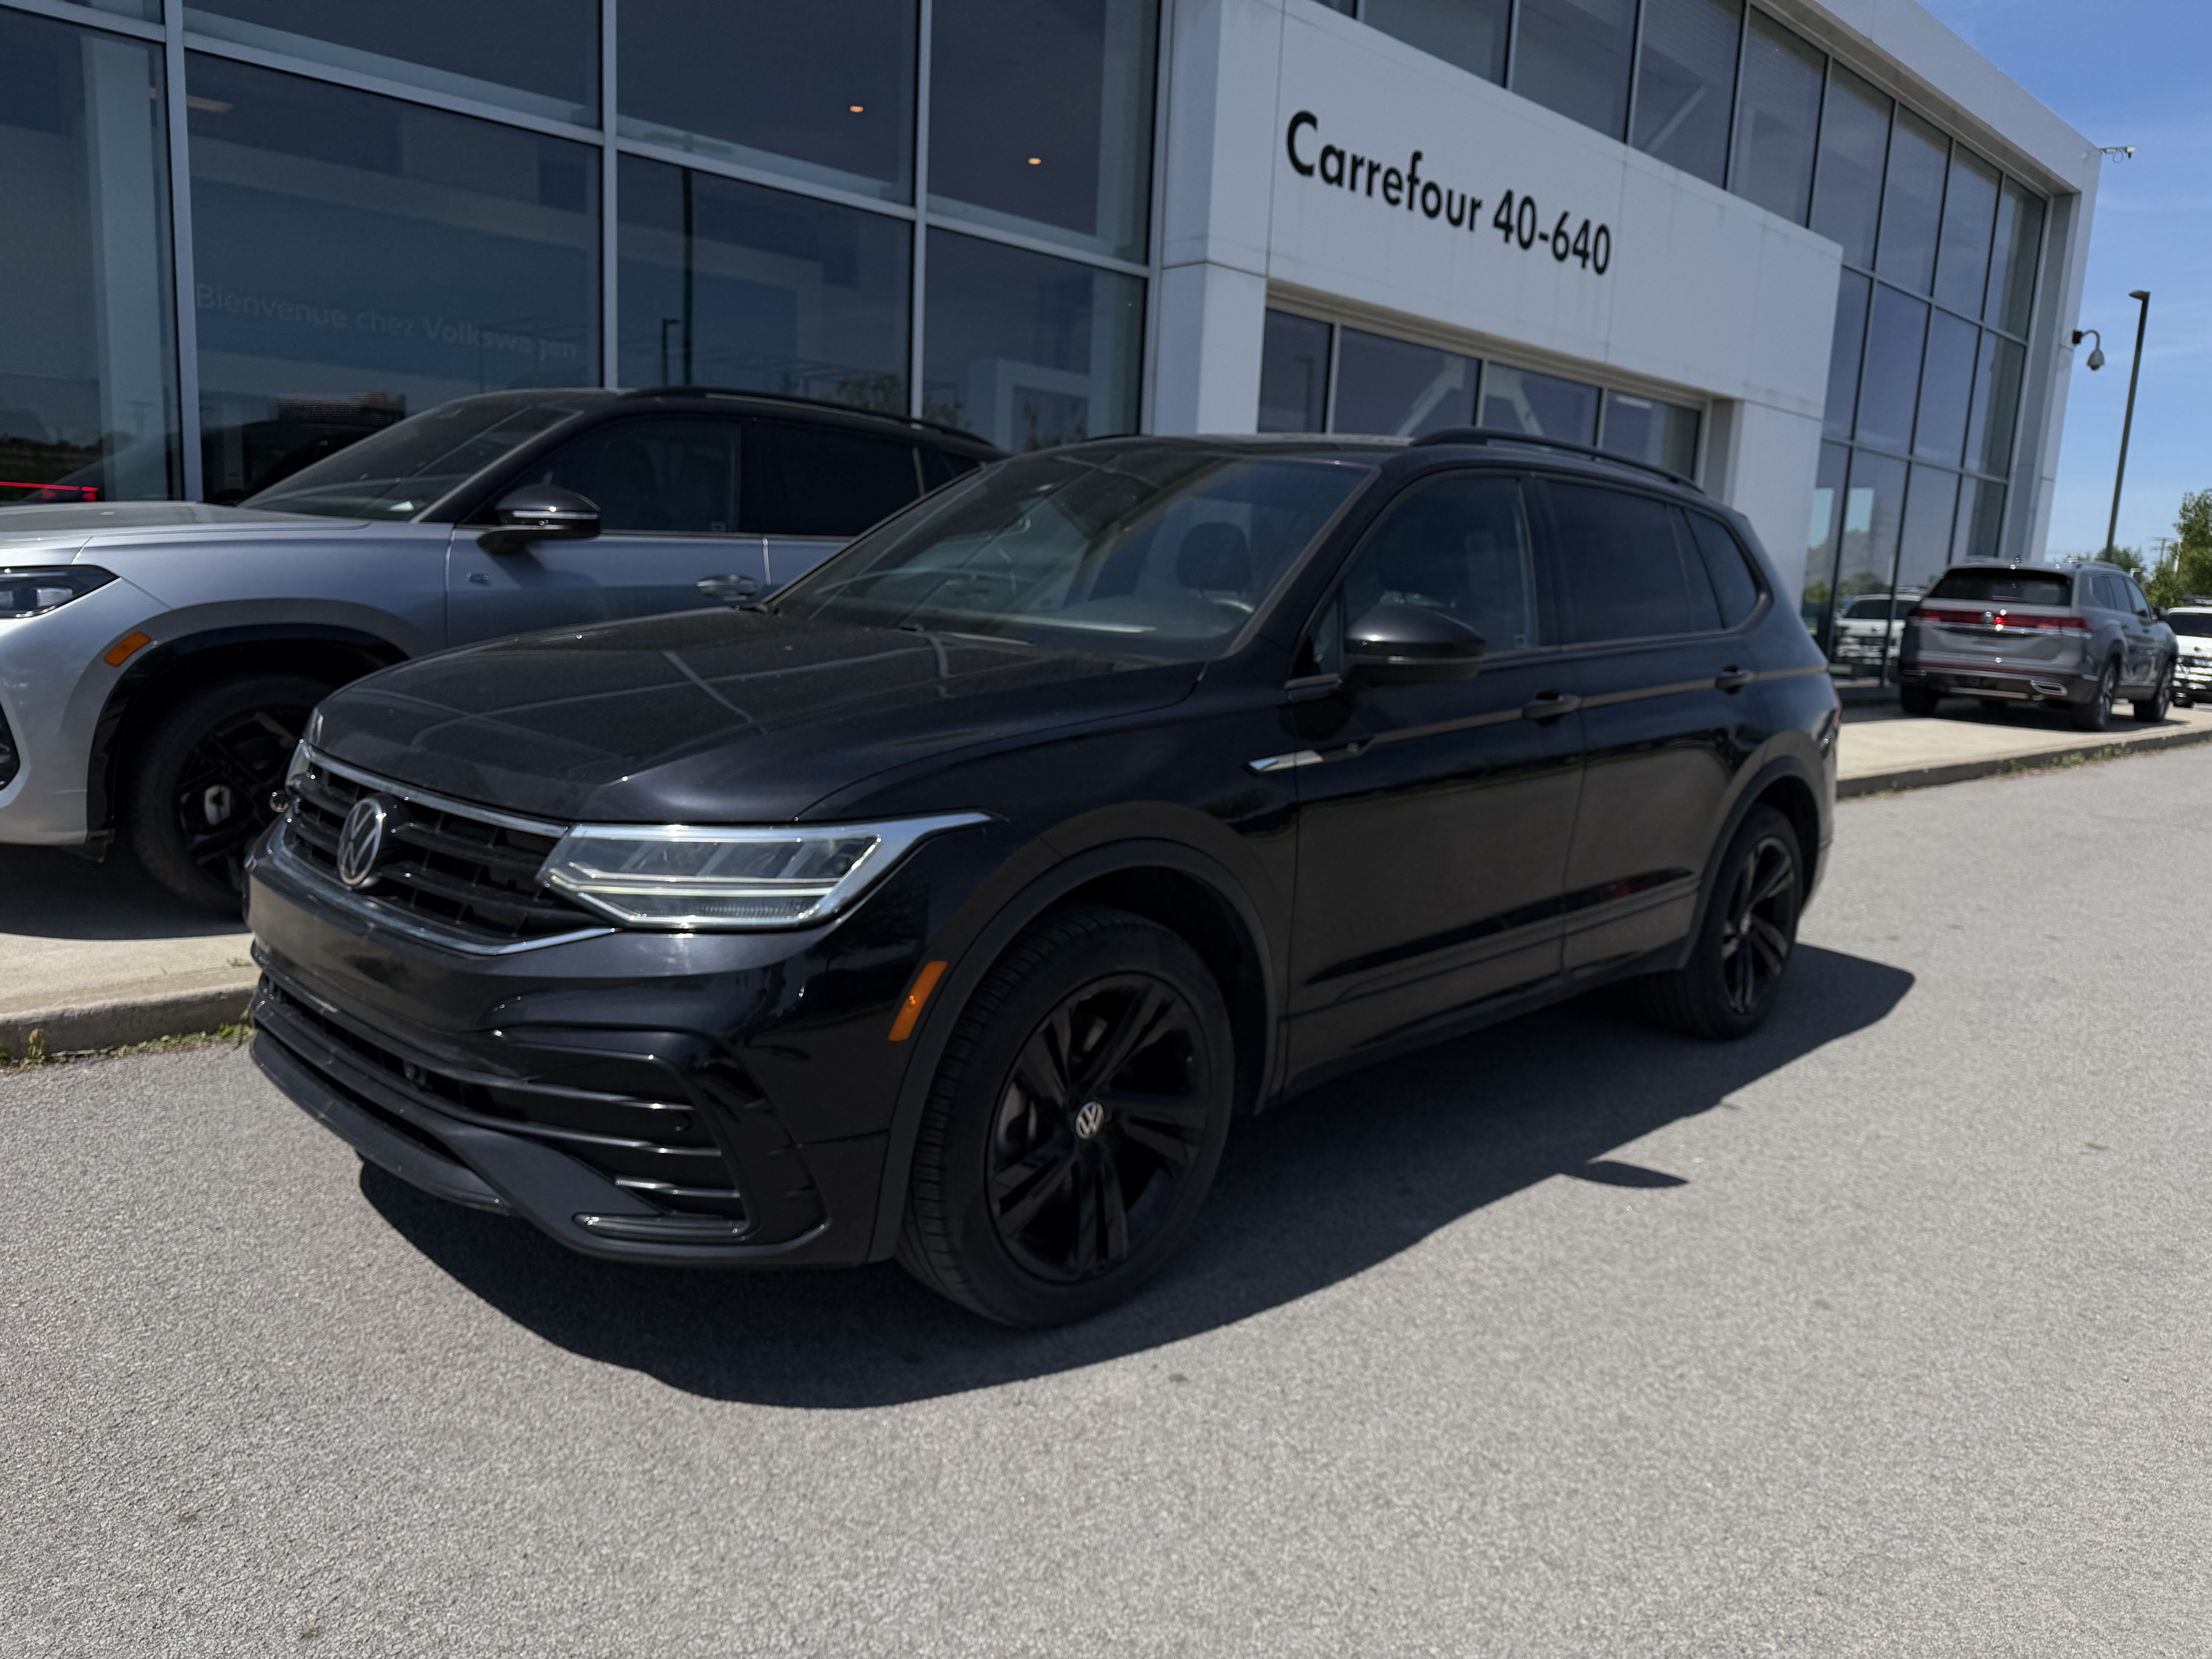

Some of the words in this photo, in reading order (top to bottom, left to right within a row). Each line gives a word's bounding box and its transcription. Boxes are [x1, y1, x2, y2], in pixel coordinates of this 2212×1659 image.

[1286, 110, 1482, 232] Carrefour
[1493, 189, 1611, 275] 40-640
[196, 283, 347, 328] Bienvenue
[356, 310, 415, 336] chez
[338, 799, 382, 884] VW
[1076, 1102, 1104, 1139] VW
